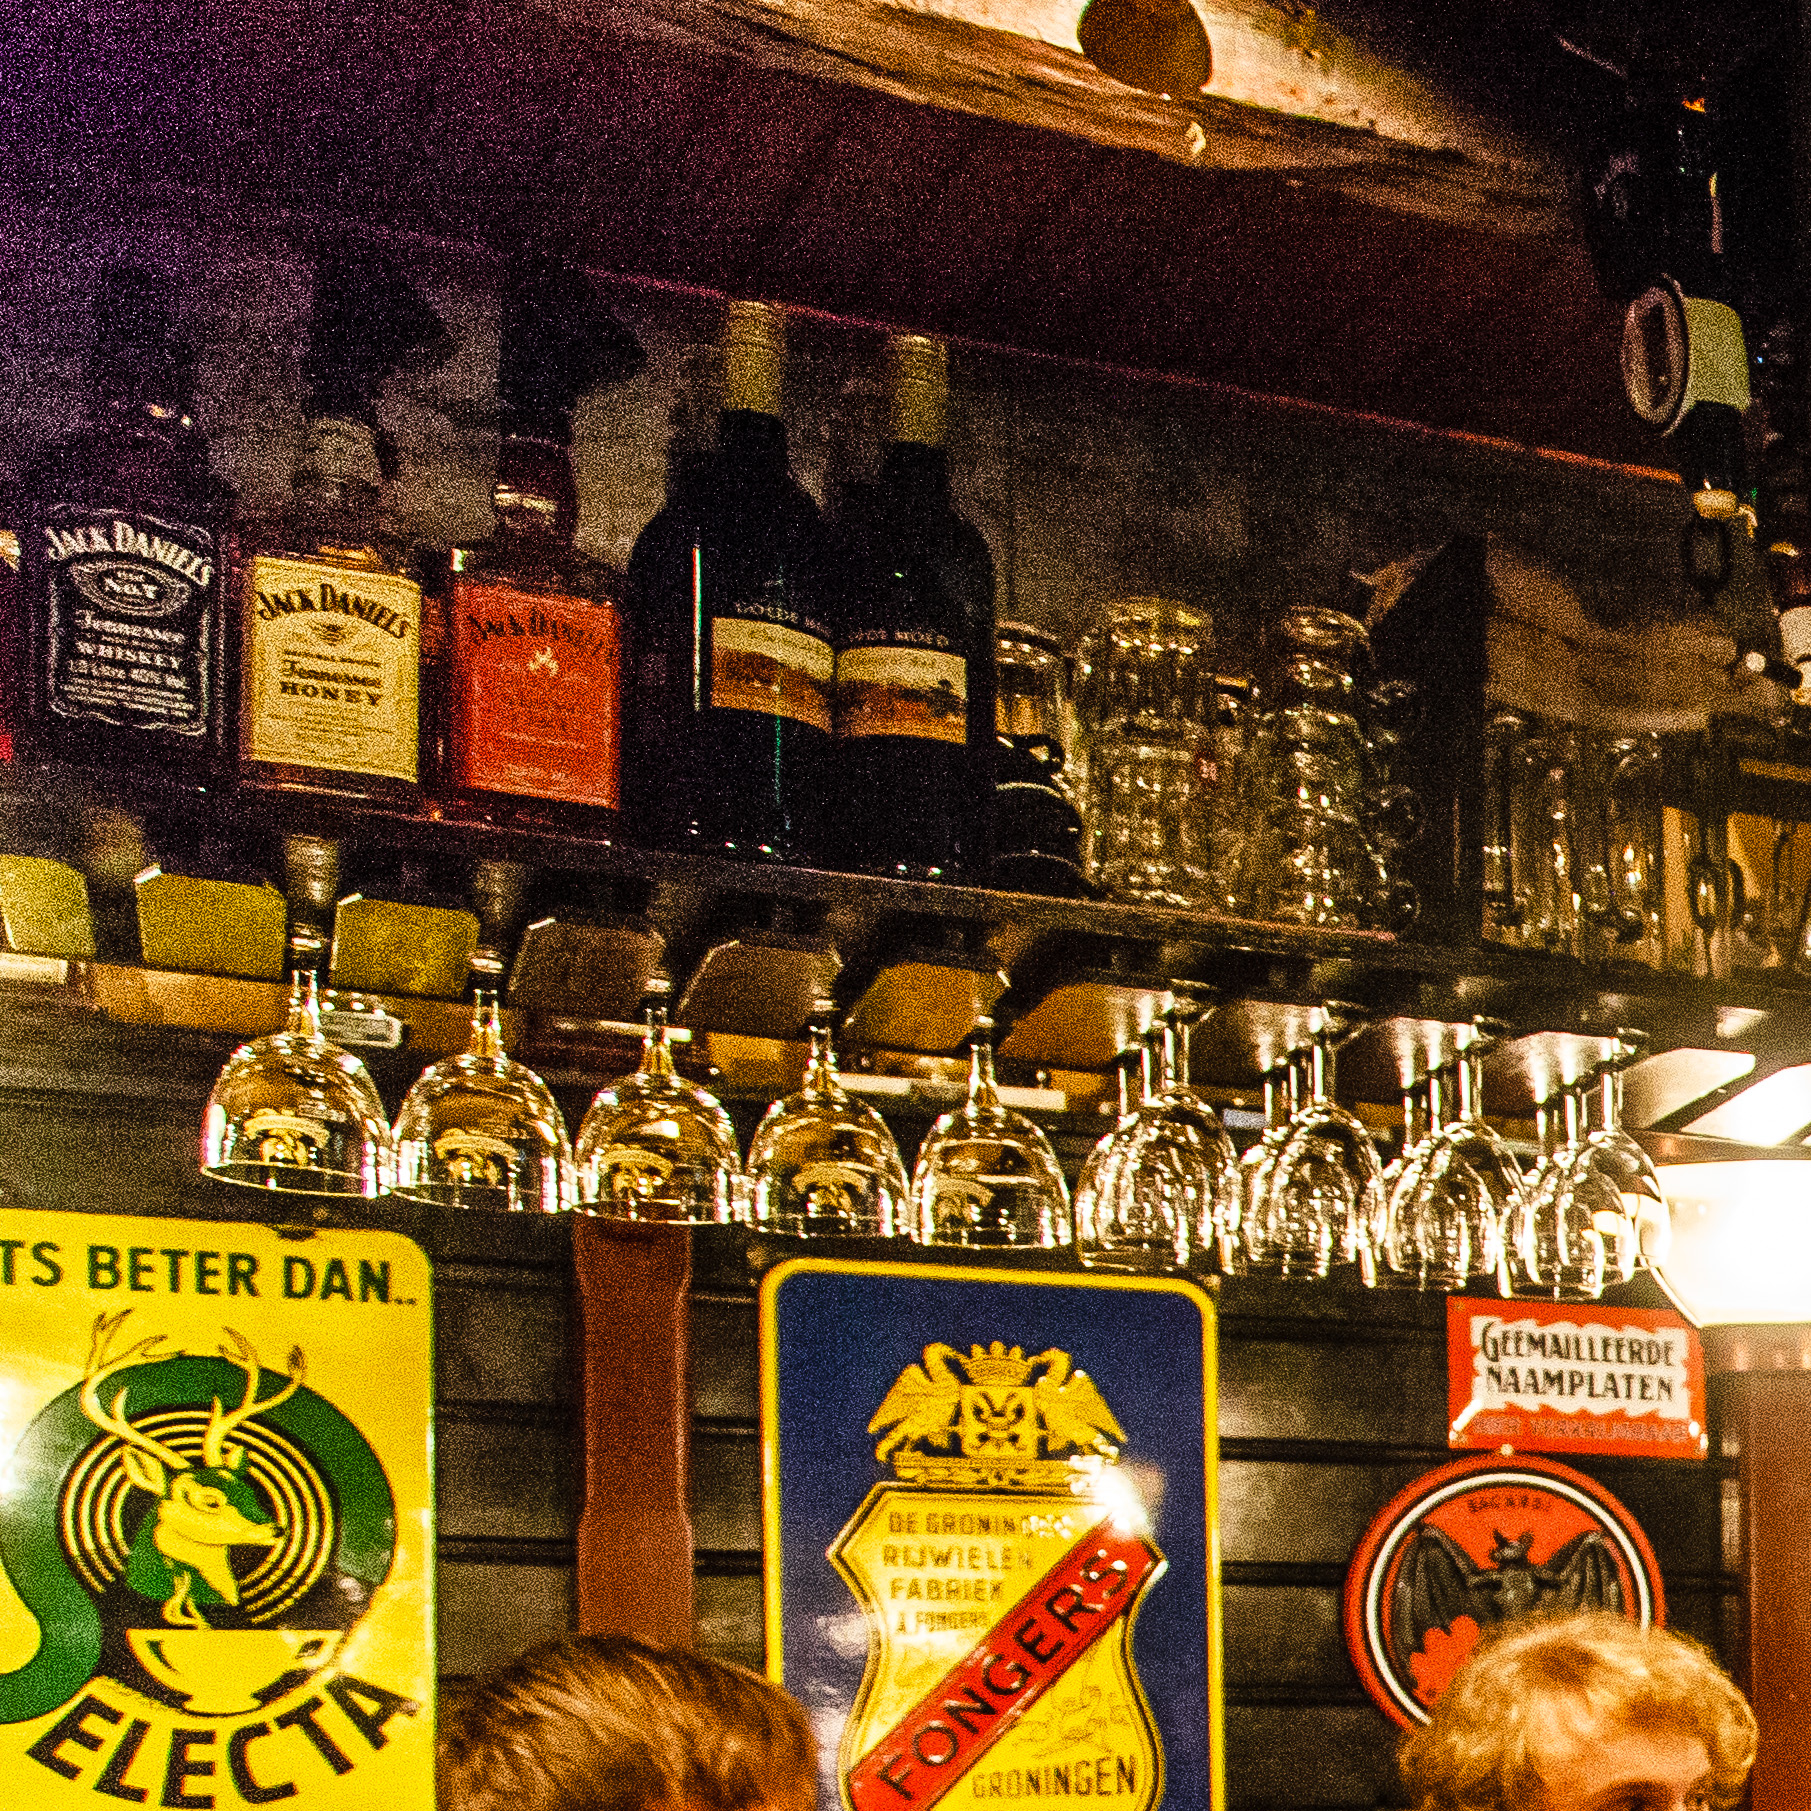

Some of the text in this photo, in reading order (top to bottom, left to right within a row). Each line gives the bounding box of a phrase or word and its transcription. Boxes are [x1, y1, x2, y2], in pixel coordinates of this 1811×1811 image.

[45, 526, 110, 562] JACK
[257, 589, 316, 622] JACK
[279, 680, 385, 707] HONEY
[86, 1245, 256, 1299] BETER
[1481, 1320, 1675, 1368] GEEMAILLEERDE
[1485, 1365, 1674, 1402] NAAMPLATEN
[888, 1510, 916, 1535] DE
[890, 1577, 1004, 1602] FABRIEK
[877, 1547, 1128, 1801] FONGERS
[972, 1755, 1137, 1800] GRONINGEN
